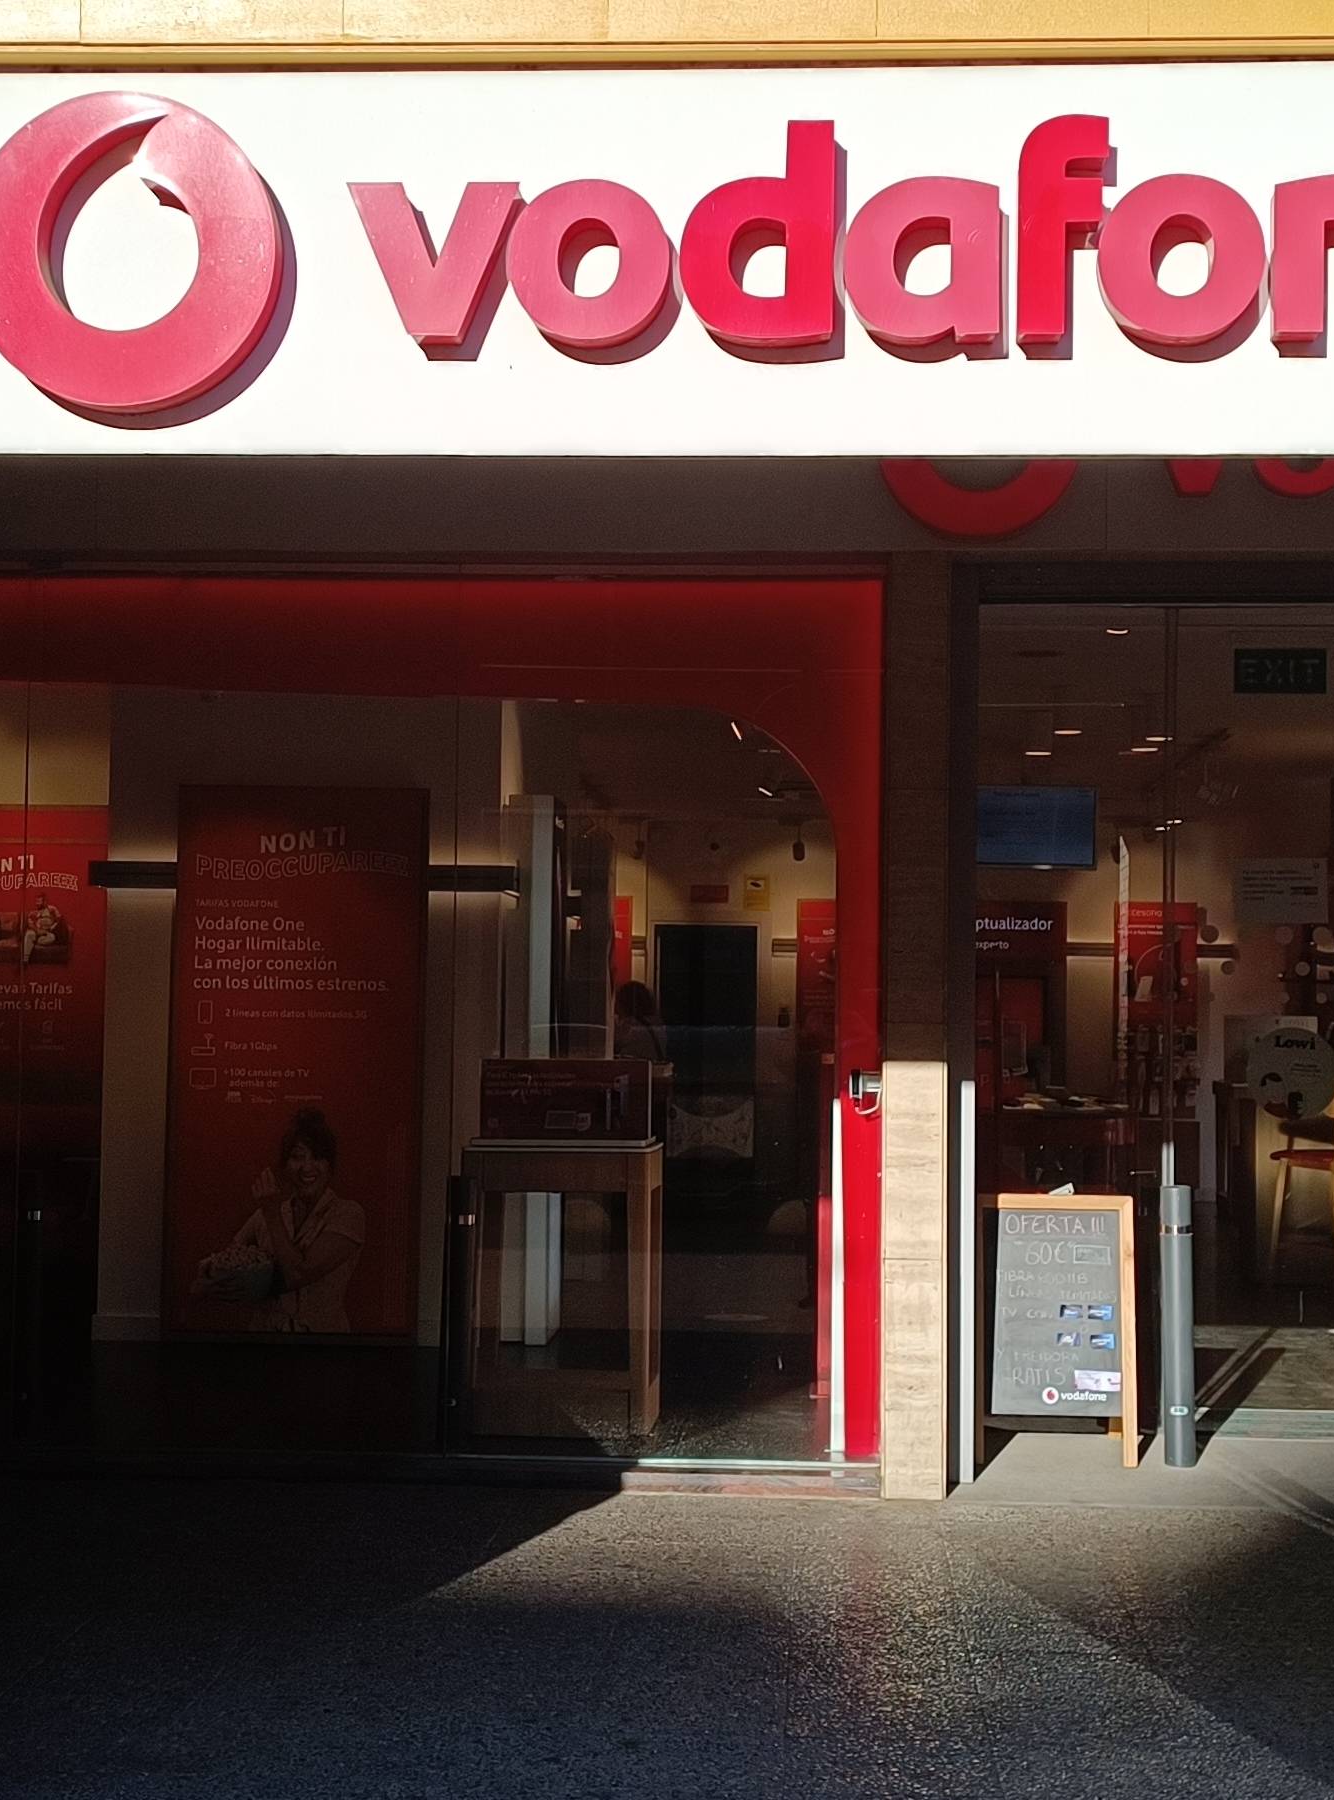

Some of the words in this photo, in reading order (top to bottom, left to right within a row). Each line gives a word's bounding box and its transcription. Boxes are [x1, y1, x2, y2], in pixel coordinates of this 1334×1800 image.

[1238, 658, 1321, 684] EXIT
[259, 828, 316, 854] NON
[322, 824, 347, 847] TI
[231, 898, 280, 909] VODAFONE
[195, 915, 270, 931] Vodafone
[272, 916, 306, 932] One
[194, 935, 243, 953] Hogar
[194, 955, 213, 970] La
[216, 955, 263, 973] mejor
[266, 955, 339, 971] conexión
[29, 981, 73, 995] Tarifas
[193, 977, 222, 990] con
[225, 975, 250, 990] los
[253, 973, 315, 991] últimos
[34, 997, 64, 1011] fácil
[1274, 1034, 1316, 1050] Lowi
[297, 1068, 310, 1078] TV
[1004, 1213, 1086, 1235] OFERTA
[1060, 1390, 1107, 1402] vodafone
